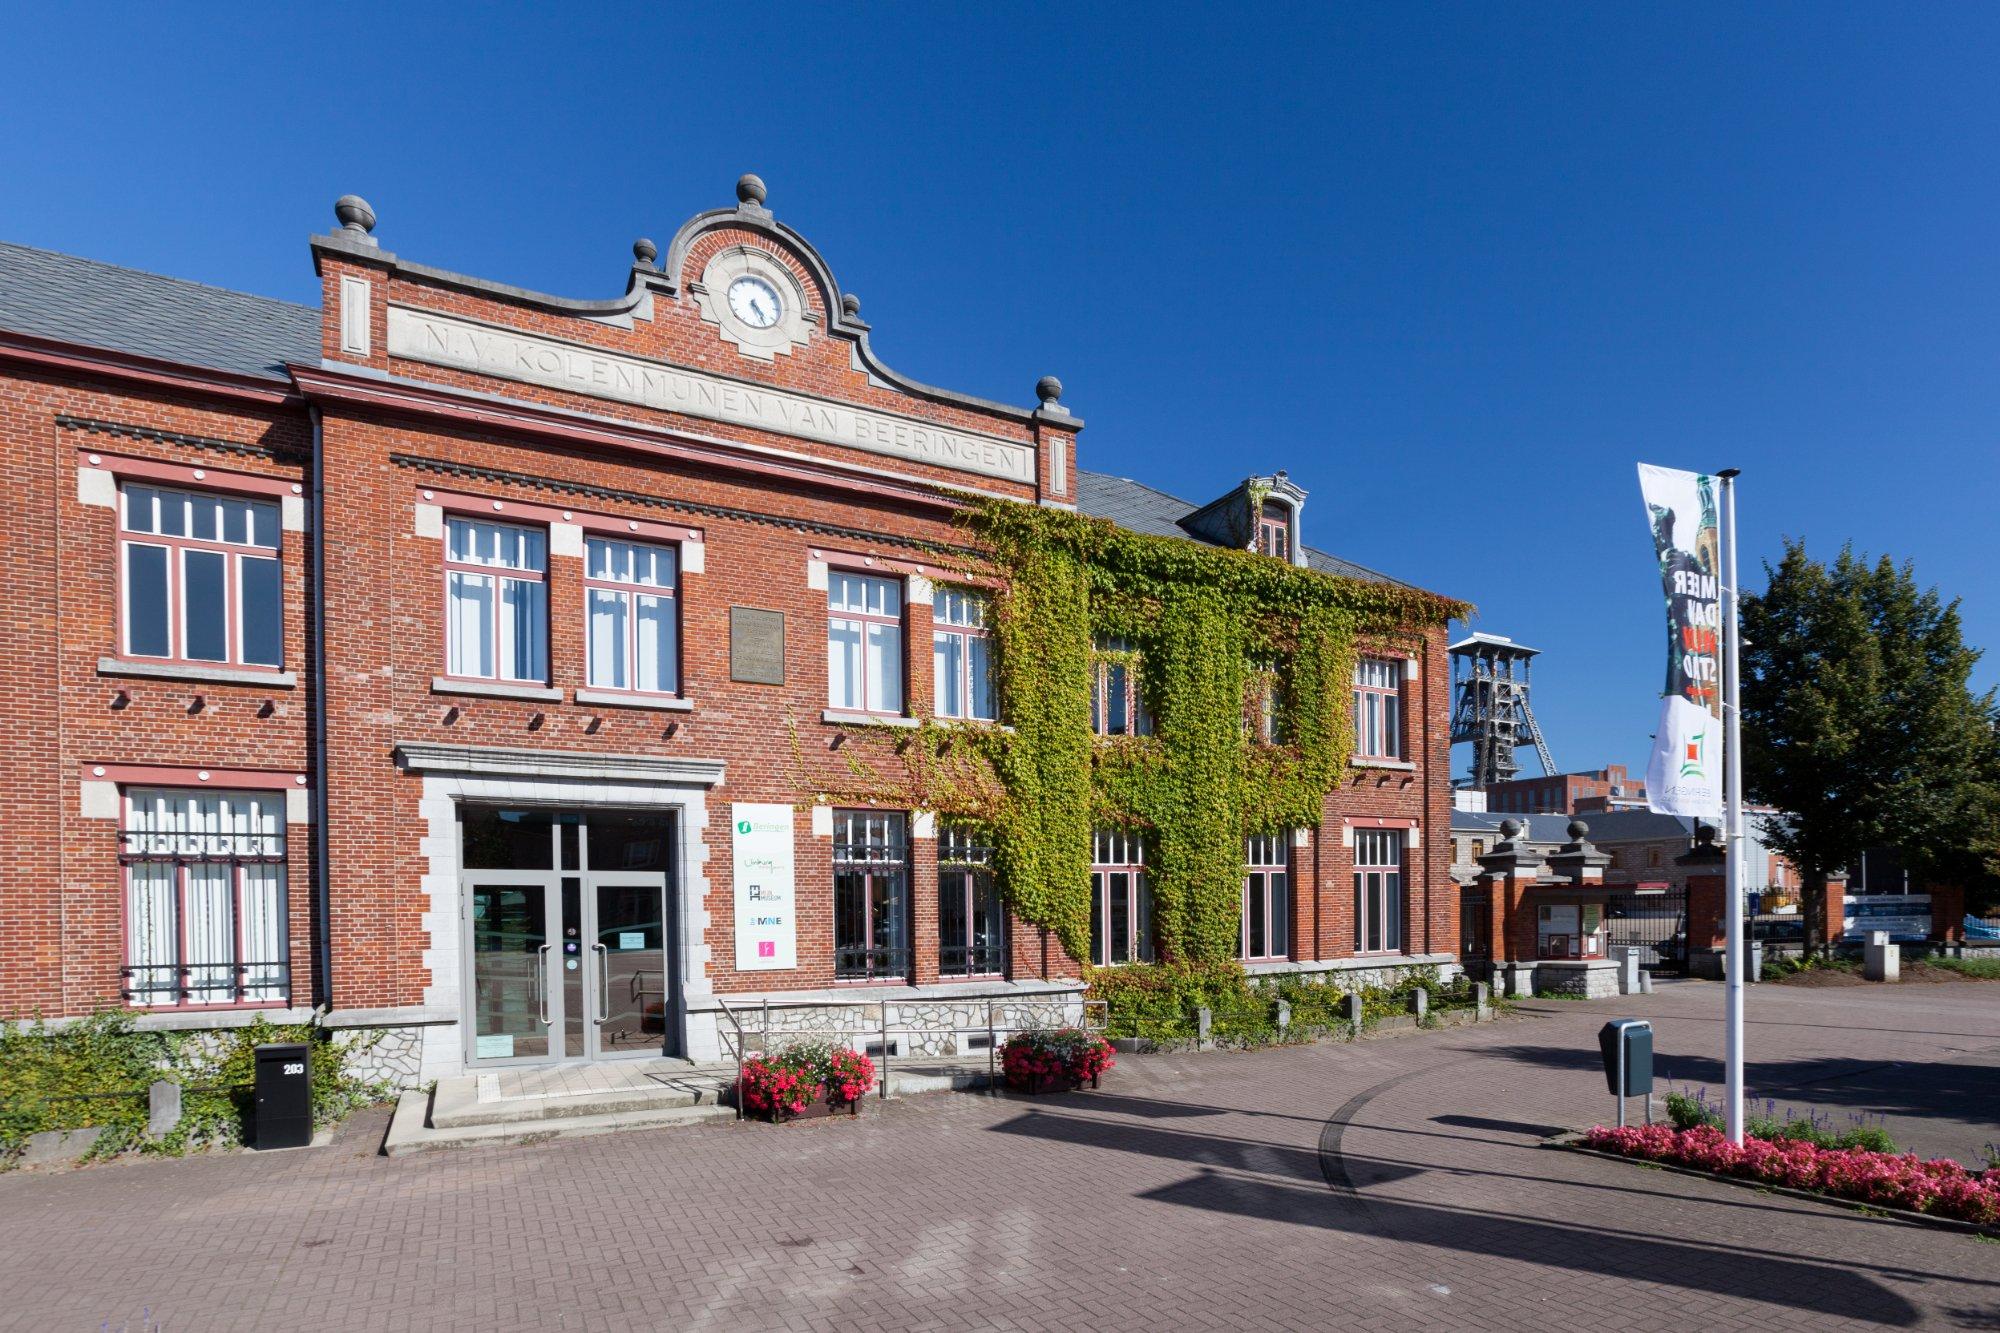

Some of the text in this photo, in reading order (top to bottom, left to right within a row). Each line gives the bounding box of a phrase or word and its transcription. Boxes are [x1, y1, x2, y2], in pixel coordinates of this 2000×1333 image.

[426, 323, 1015, 472] N.V. KOLENMIJNEN VAN BEERINGEN
[284, 1064, 304, 1074] 203
